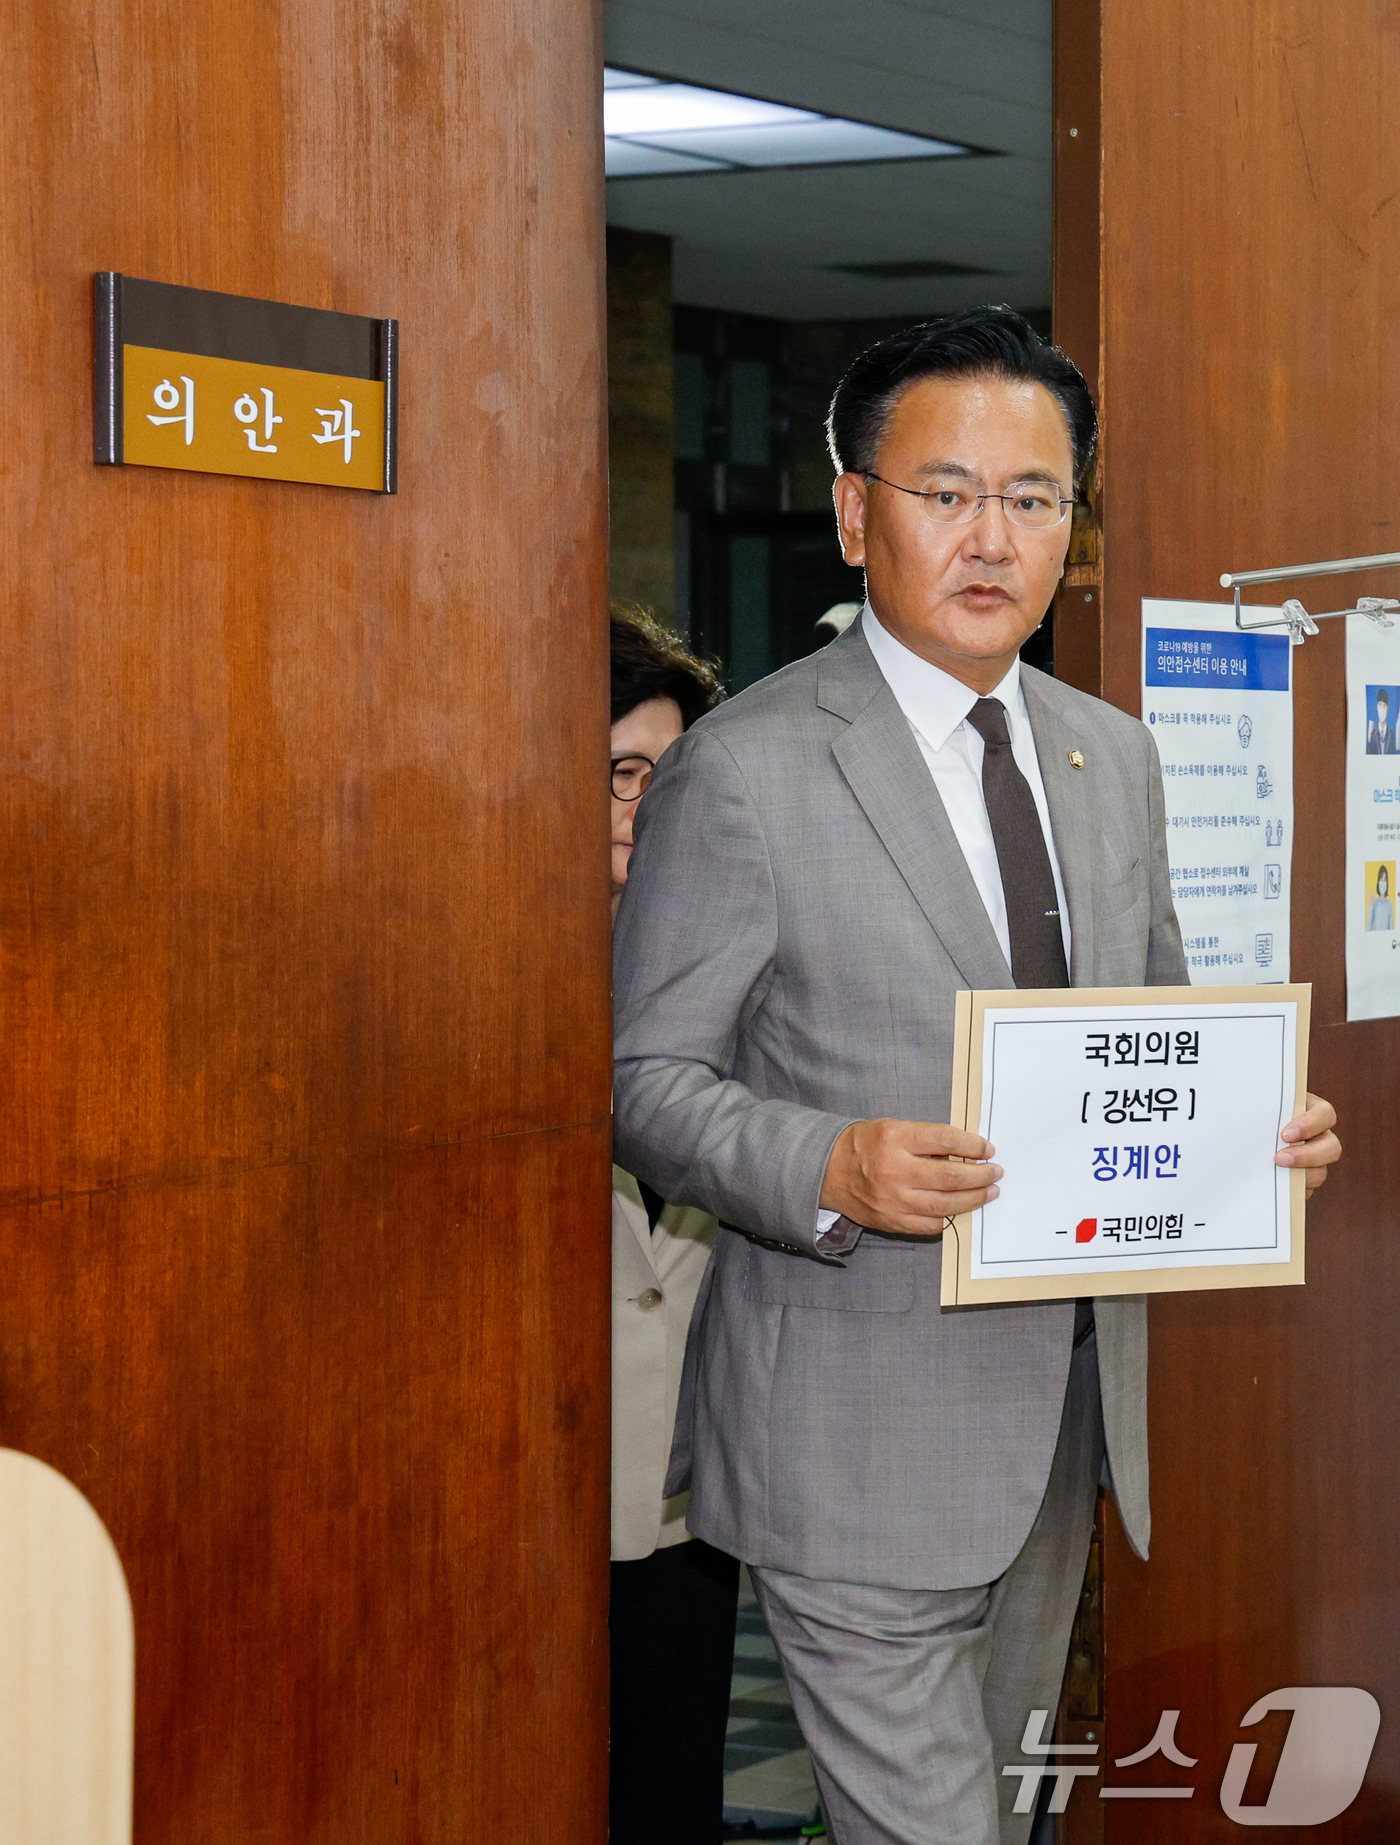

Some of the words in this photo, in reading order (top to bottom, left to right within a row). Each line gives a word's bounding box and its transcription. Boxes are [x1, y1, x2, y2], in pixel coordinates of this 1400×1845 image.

[146, 375, 361, 464] 의안과
[1157, 641, 1181, 653] 코로나19
[1182, 642, 1199, 654] 예방을
[1200, 643, 1212, 655] 위한
[1157, 656, 1209, 674] 의안접수센터
[1211, 657, 1228, 675] 이용
[1230, 659, 1247, 676] 안내
[1158, 713, 1181, 725] 마스크를
[1190, 713, 1208, 725] 착용해
[1209, 713, 1232, 725] 주십시오
[1178, 765, 1205, 776] 손소독제를
[1207, 765, 1224, 776] 이용해
[1226, 765, 1248, 776] 주십시오
[1172, 816, 1189, 827] 대기시
[1191, 816, 1219, 828] 안전거리를
[1221, 816, 1238, 827] 준수해
[1239, 816, 1261, 827] 주십시오
[1200, 867, 1221, 879] 접수센터
[1222, 953, 1244, 965] 주십시오
[1084, 1031, 1200, 1067] 국회의원
[1102, 1087, 1179, 1124] 강선우
[1091, 1144, 1182, 1182] 징계안
[1101, 1213, 1184, 1243] 국민의힘
